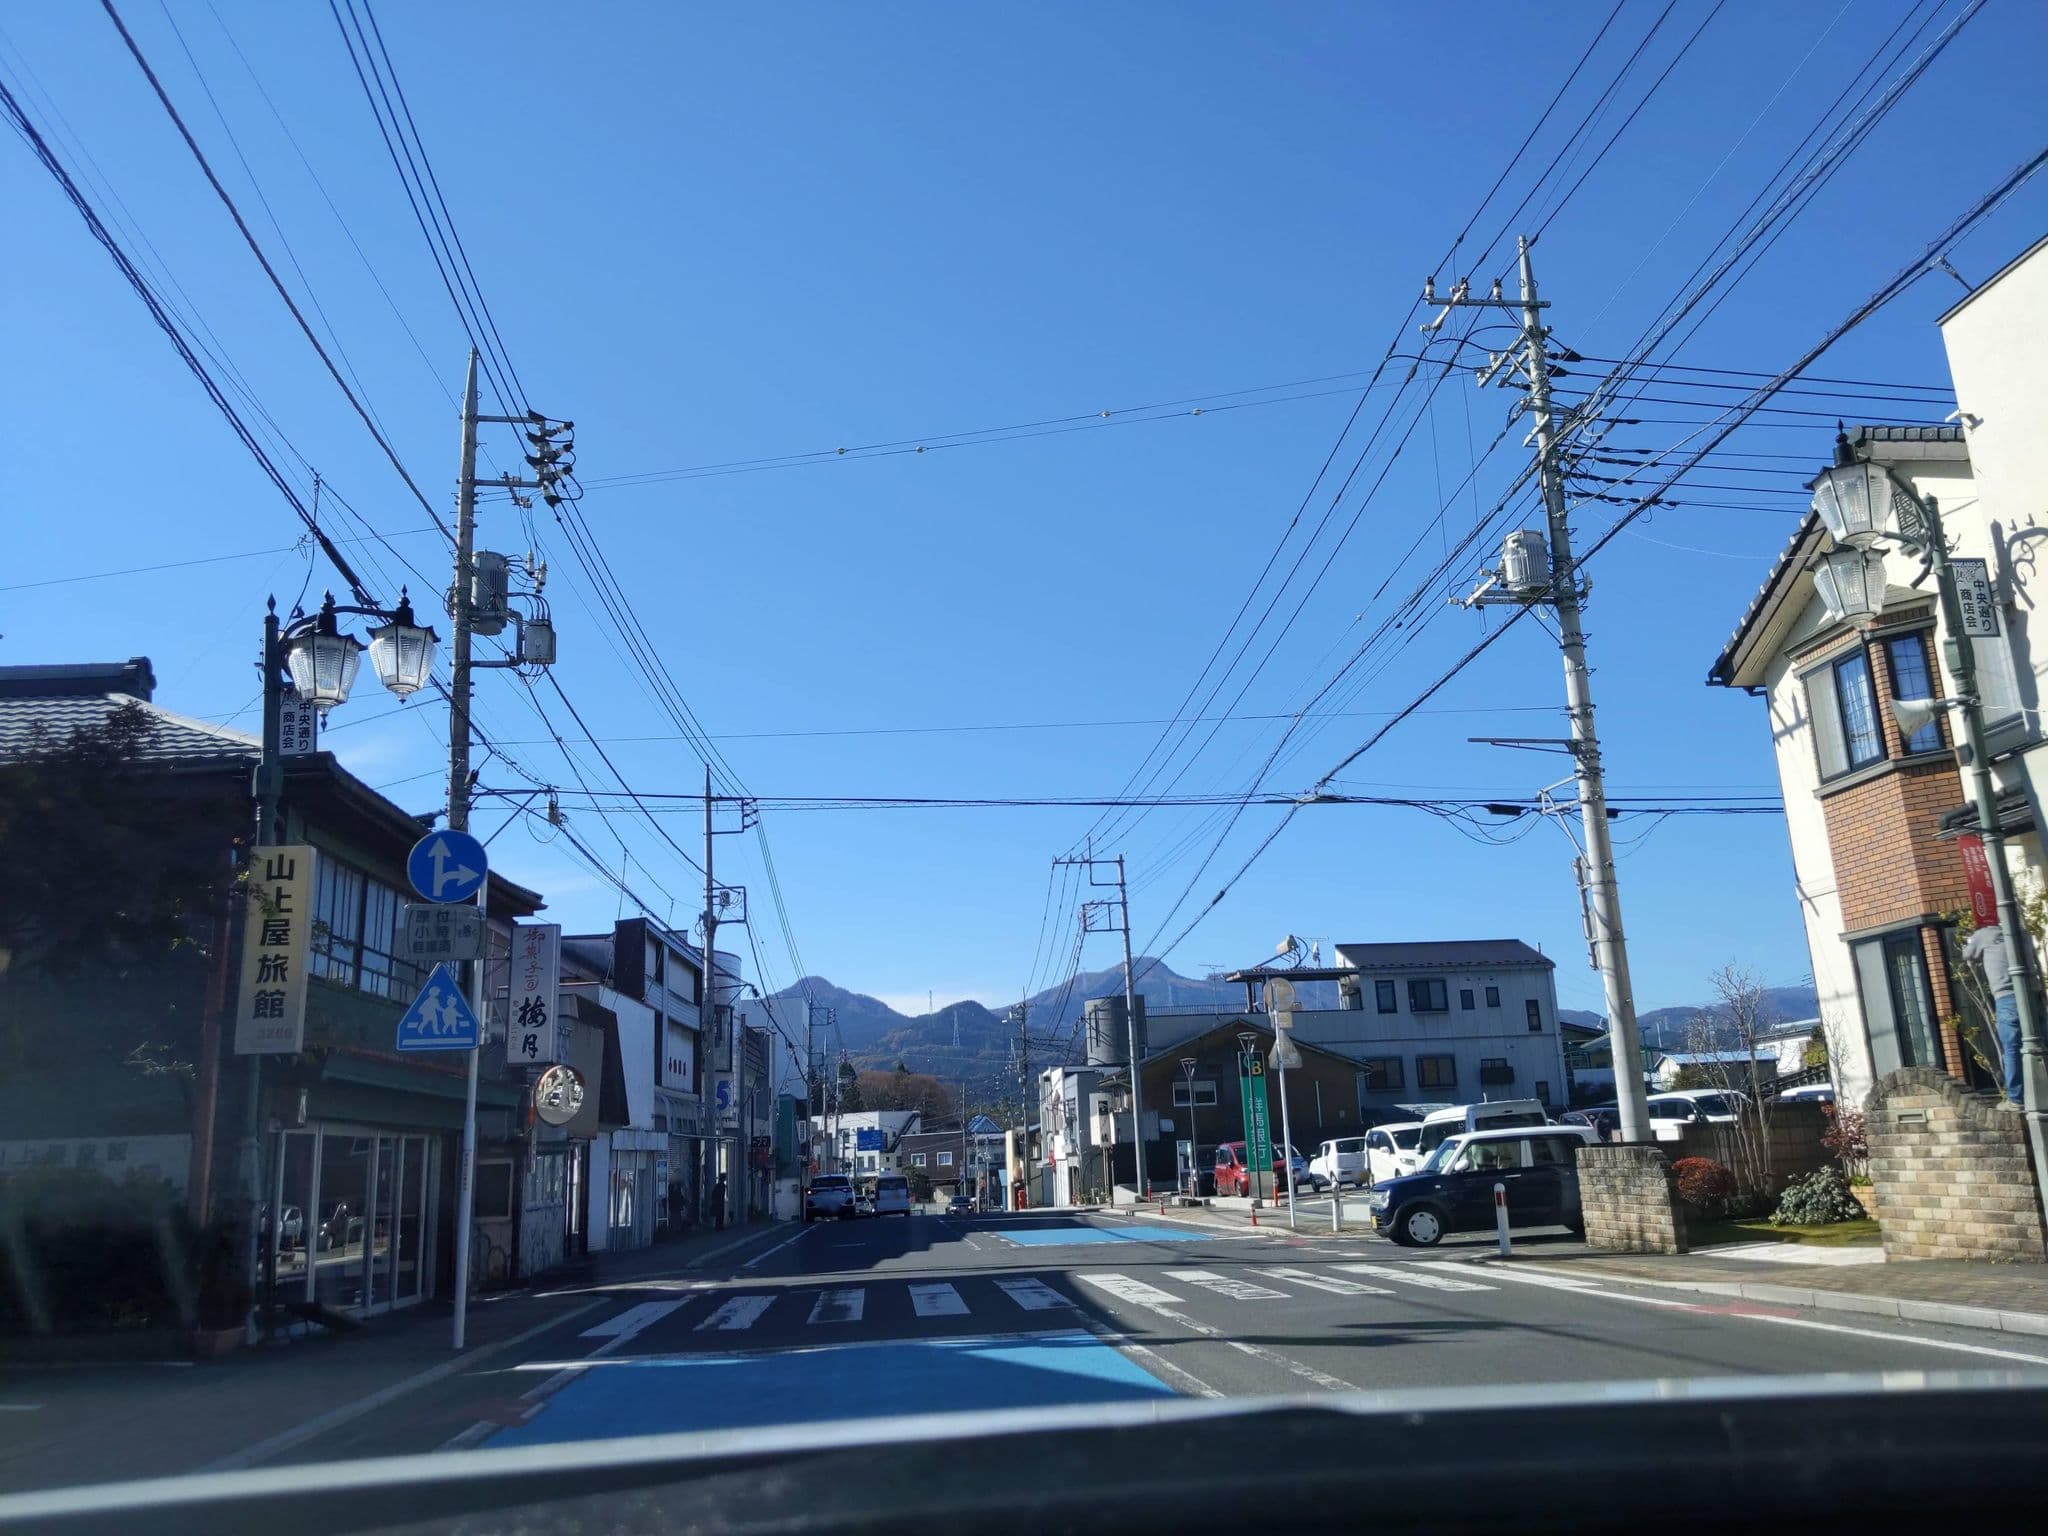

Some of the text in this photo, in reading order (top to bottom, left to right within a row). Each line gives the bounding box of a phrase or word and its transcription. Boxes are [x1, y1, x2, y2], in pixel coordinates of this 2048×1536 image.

[1960, 588, 1977, 628] 商店会
[1973, 579, 1992, 631] 中央通り
[282, 711, 295, 749] 商店会
[299, 702, 311, 751] 中央通り
[253, 854, 294, 1019] 山上屋旅館
